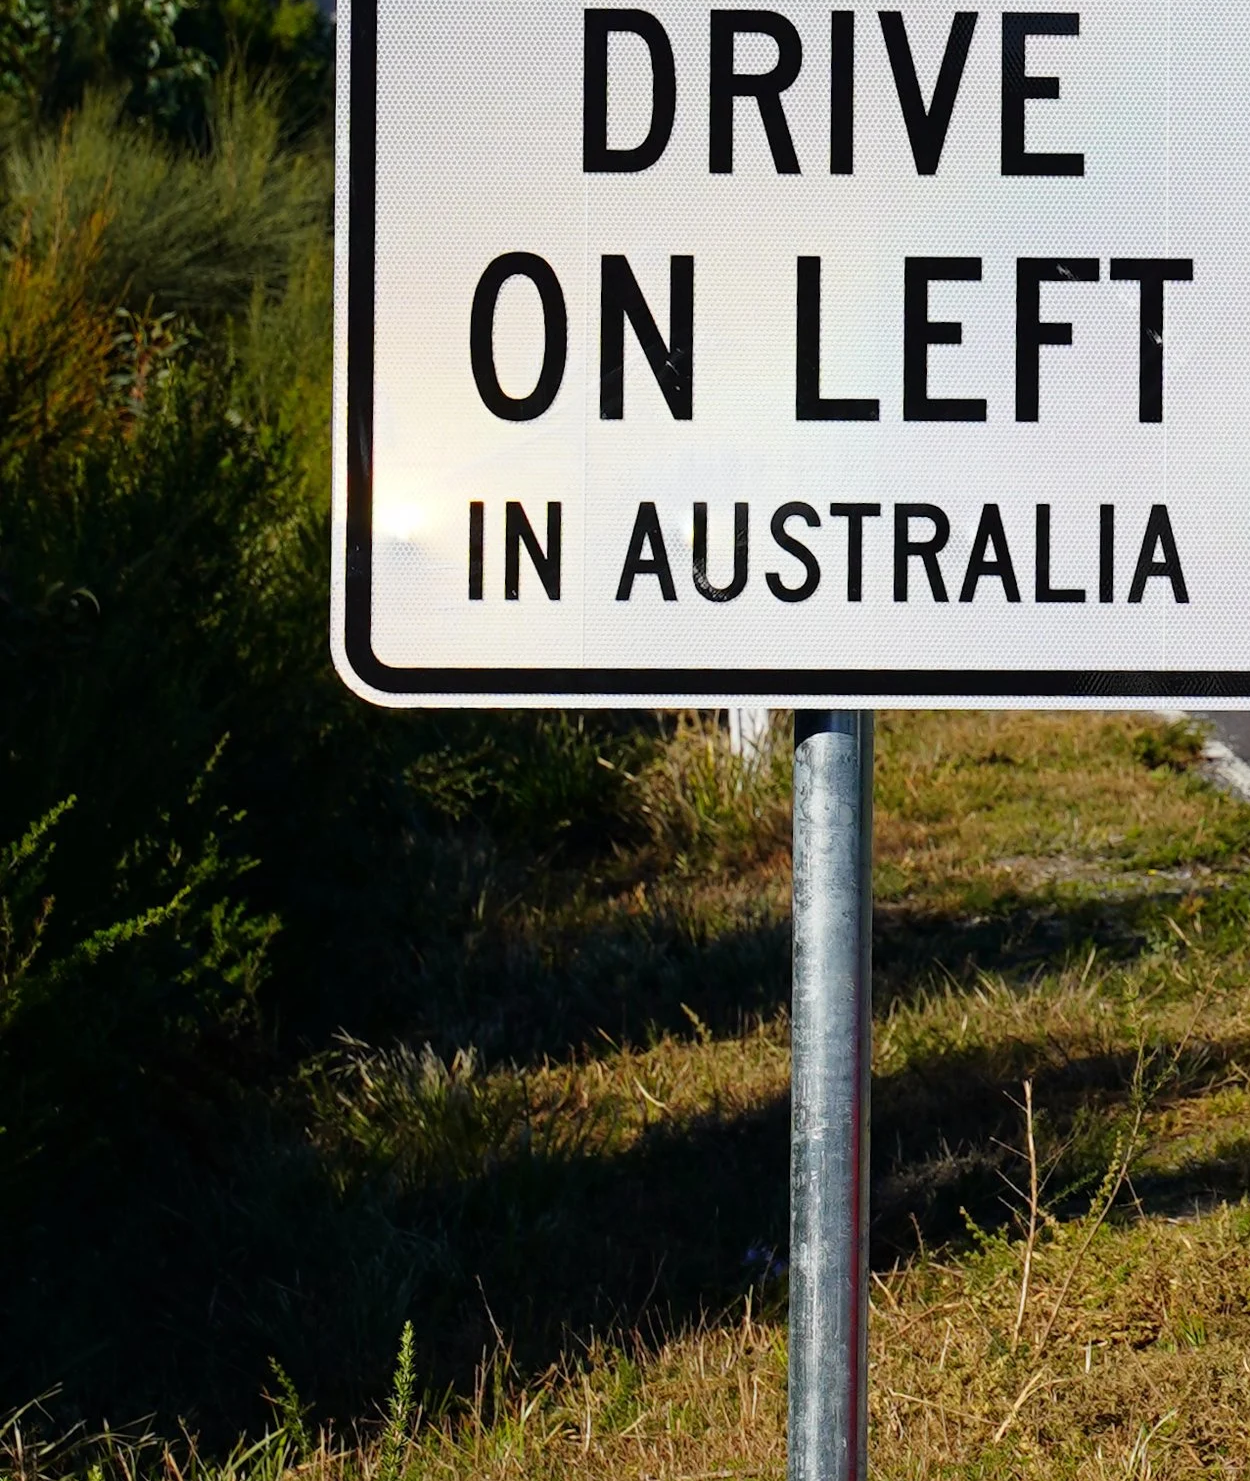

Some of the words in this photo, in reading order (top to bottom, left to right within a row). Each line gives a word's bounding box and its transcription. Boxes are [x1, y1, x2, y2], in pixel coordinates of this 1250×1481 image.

[583, 8, 1084, 176] DRIVE
[470, 252, 694, 421] ON
[796, 256, 1193, 423] LEFT
[469, 502, 561, 601] IN
[616, 502, 1189, 603] AUSTRALIA
